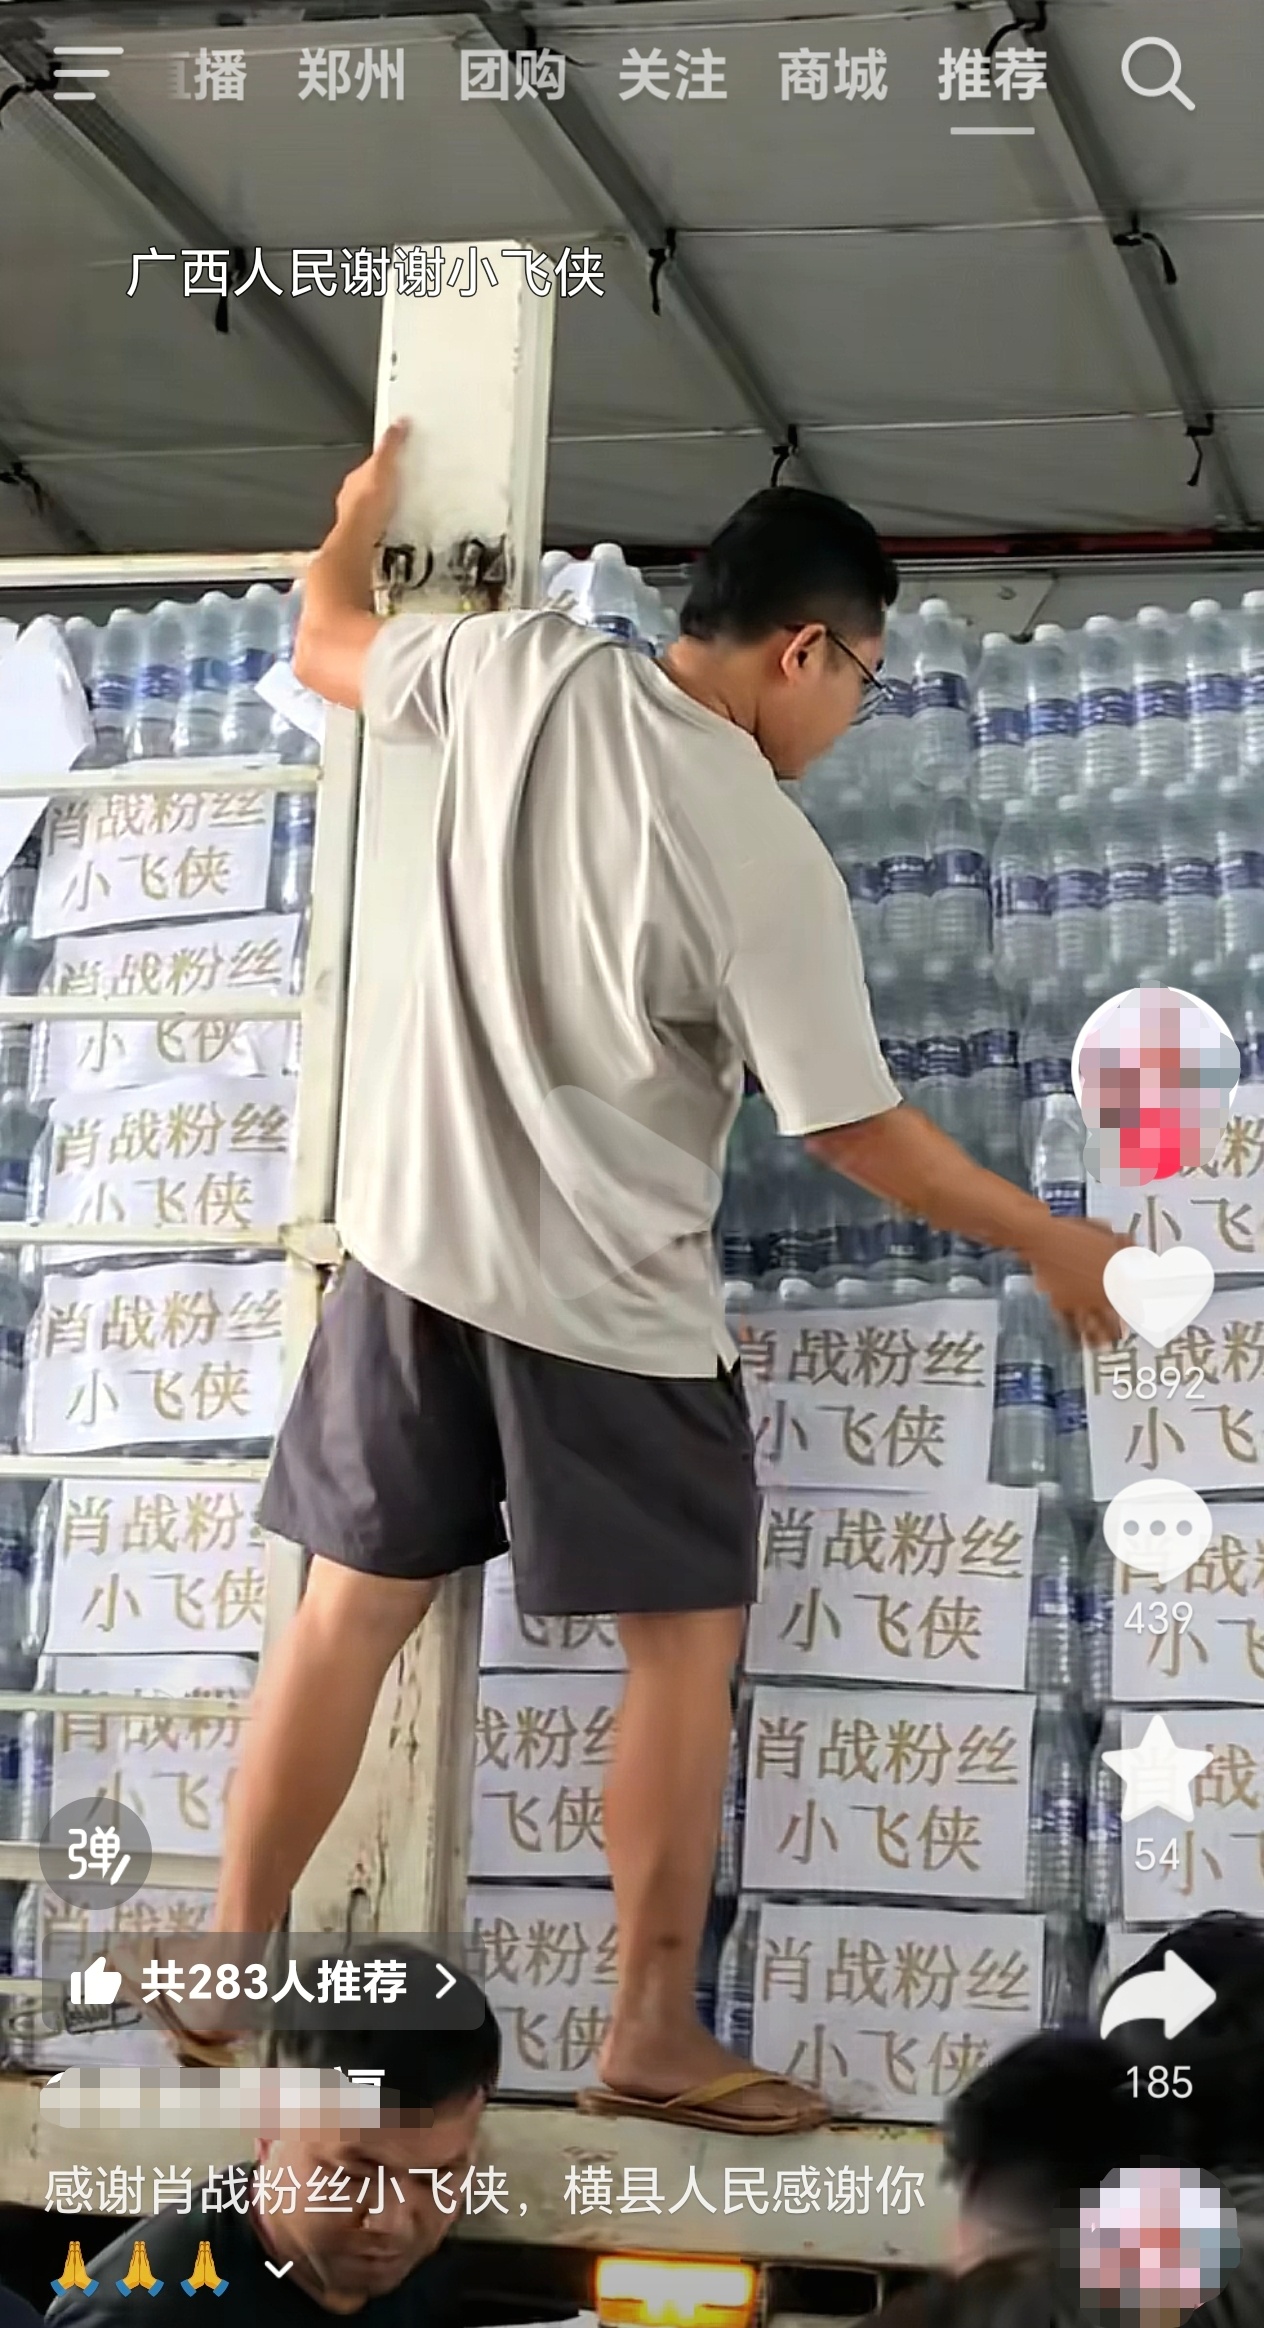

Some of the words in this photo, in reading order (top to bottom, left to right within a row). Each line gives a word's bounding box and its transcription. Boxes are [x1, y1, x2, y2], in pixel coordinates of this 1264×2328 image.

[46, 791, 267, 857] 肖战粉丝
[61, 844, 232, 912] 小飞侠
[58, 937, 284, 996] 肖战粉丝
[54, 1101, 289, 1174] 肖战粉丝
[79, 1171, 255, 1228] 小飞侠
[44, 1287, 283, 1359] 肖战粉丝
[739, 1325, 987, 1388] 肖战粉丝
[65, 1360, 250, 1427] 小飞侠
[755, 1398, 947, 1468] 小飞侠
[62, 1491, 265, 1559] 肖战粉
[764, 1506, 1025, 1578] 肖战粉丝
[81, 1567, 265, 1633] 小飞侠
[778, 1586, 984, 1660] 小飞侠
[754, 1715, 1020, 1787] 肖战粉丝
[777, 1798, 982, 1872] 小飞侠
[761, 1936, 1031, 2012] 肖战粉丝
[786, 2022, 990, 2097] 小飞侠
